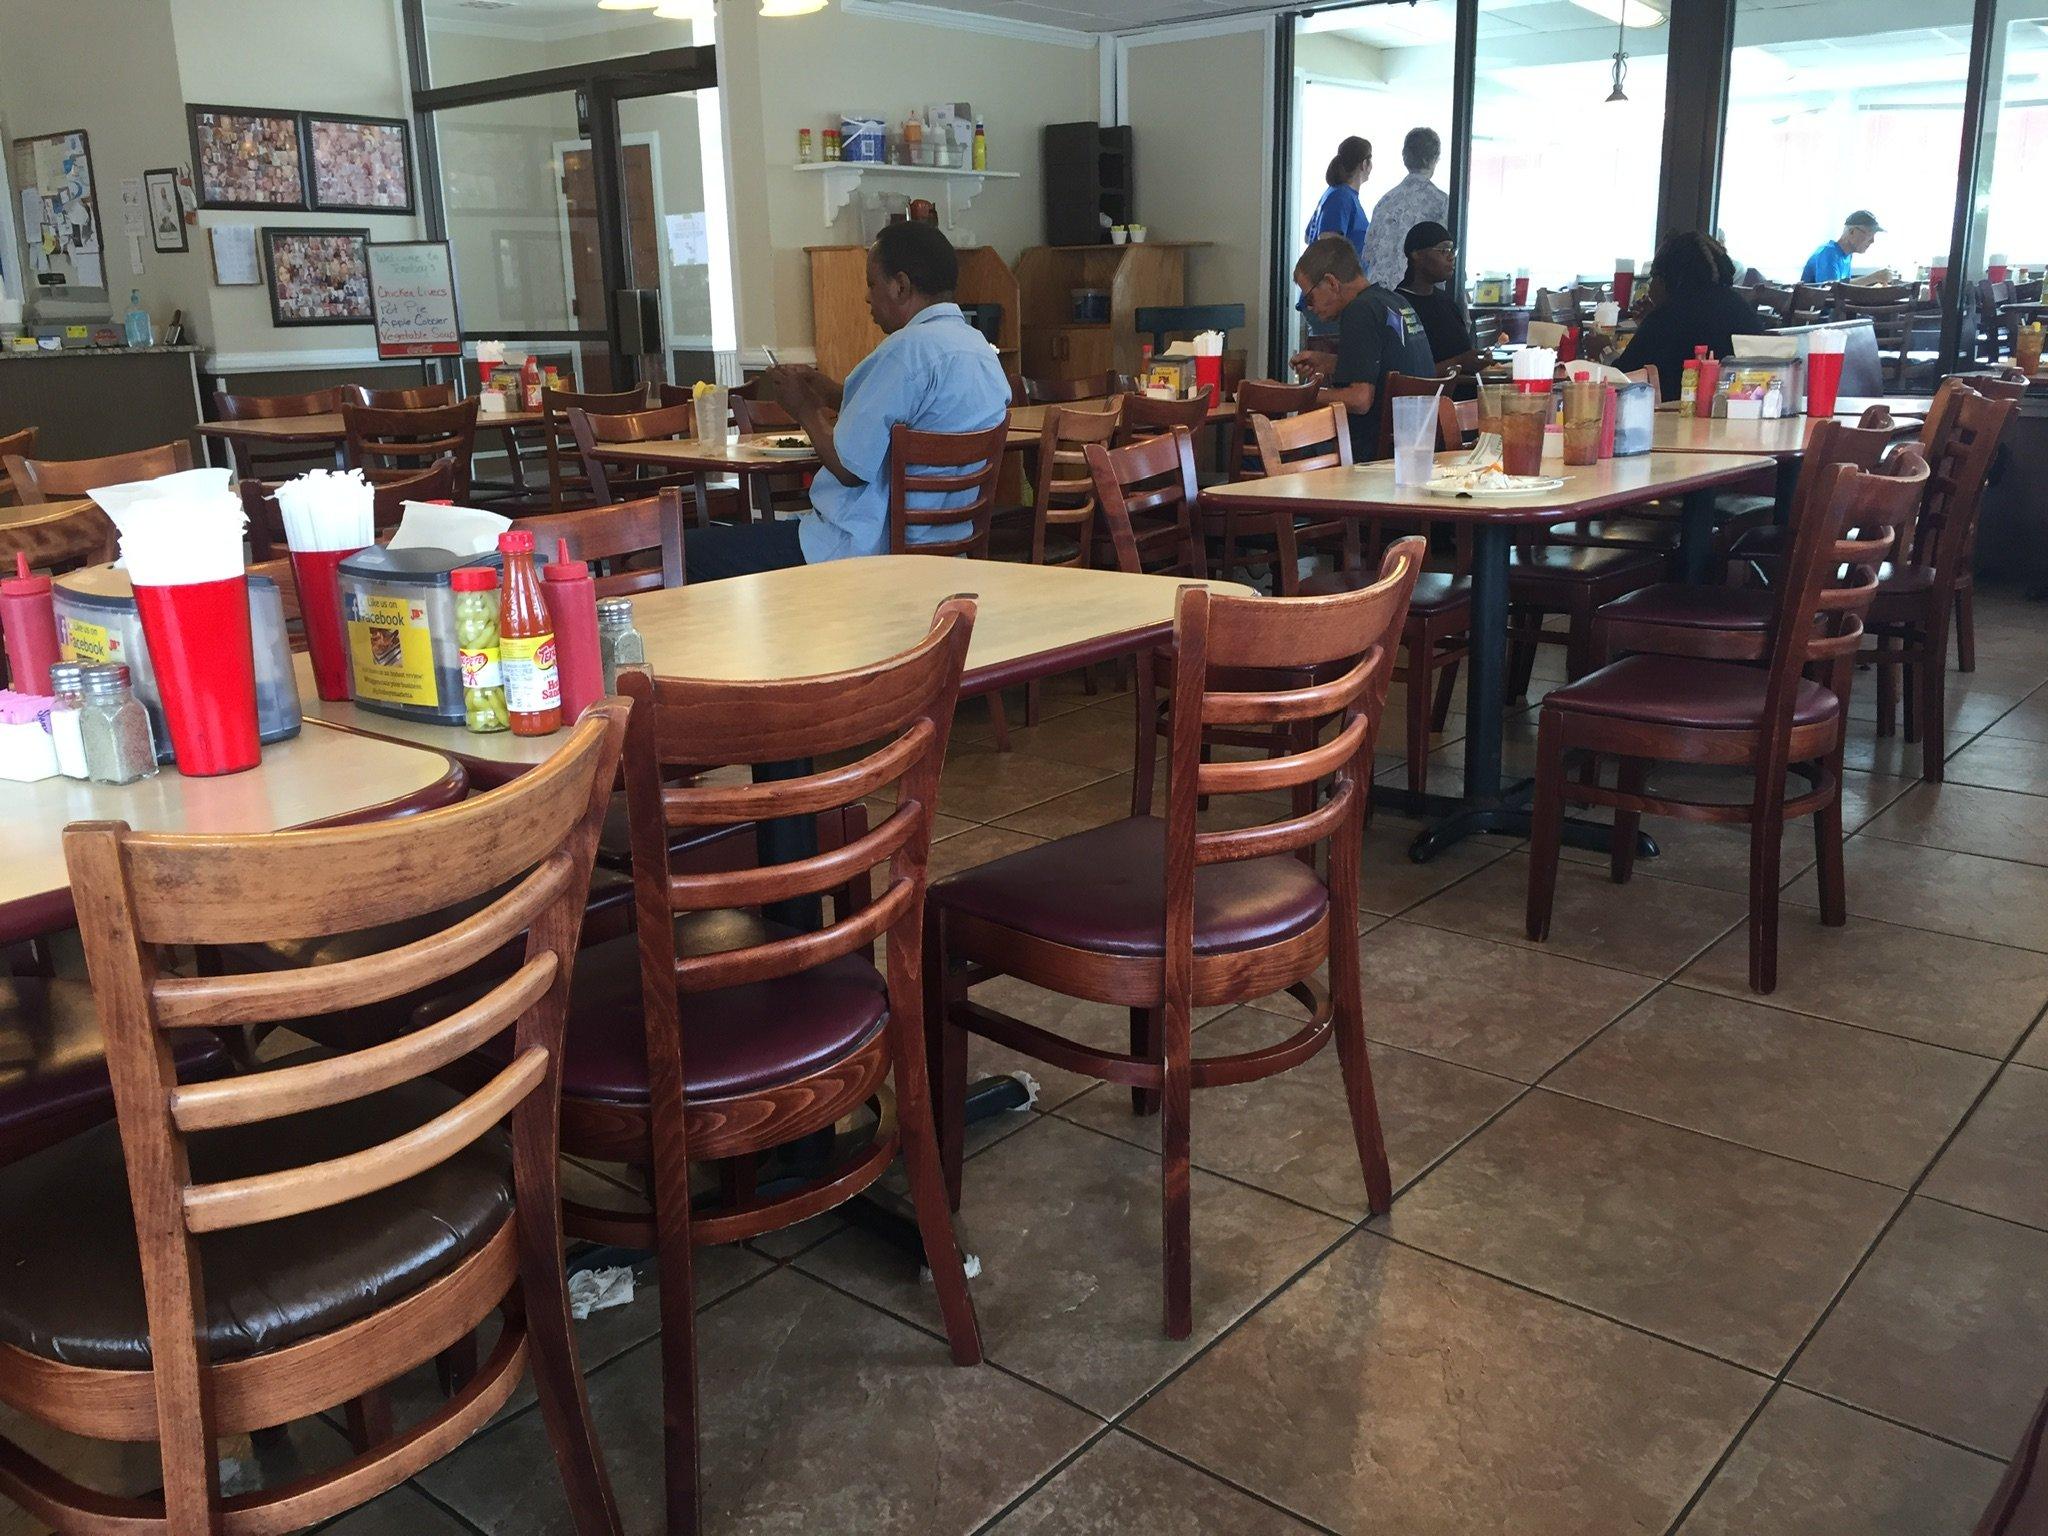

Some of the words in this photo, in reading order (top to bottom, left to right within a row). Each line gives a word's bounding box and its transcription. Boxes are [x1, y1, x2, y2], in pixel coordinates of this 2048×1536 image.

[378, 286, 415, 298] Chicken
[418, 286, 448, 297] Livers
[380, 301, 398, 315] Pot
[404, 300, 427, 314] Pie
[380, 317, 411, 328] Apple
[414, 314, 448, 326] Cobbler
[380, 327, 427, 342] Vegetable
[431, 327, 457, 340] Soup
[368, 598, 380, 608] Like
[381, 600, 388, 608] us
[388, 601, 398, 609] on
[547, 680, 560, 690] Ho
